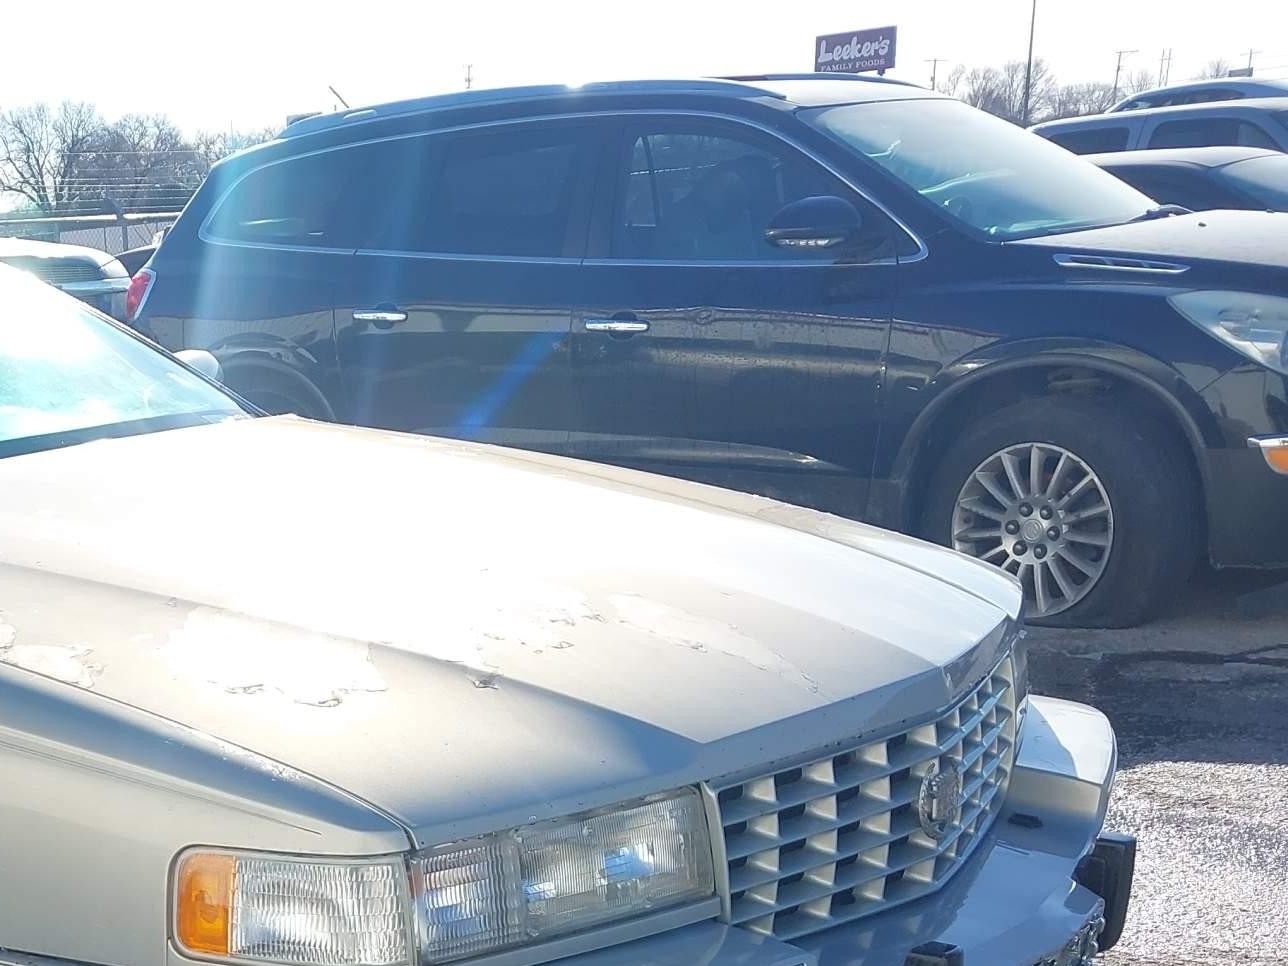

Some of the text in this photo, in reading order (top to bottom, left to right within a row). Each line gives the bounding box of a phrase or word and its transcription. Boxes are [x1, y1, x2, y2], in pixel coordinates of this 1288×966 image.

[818, 36, 890, 63] Leeker's
[821, 58, 886, 72] FAMILY FOODS
